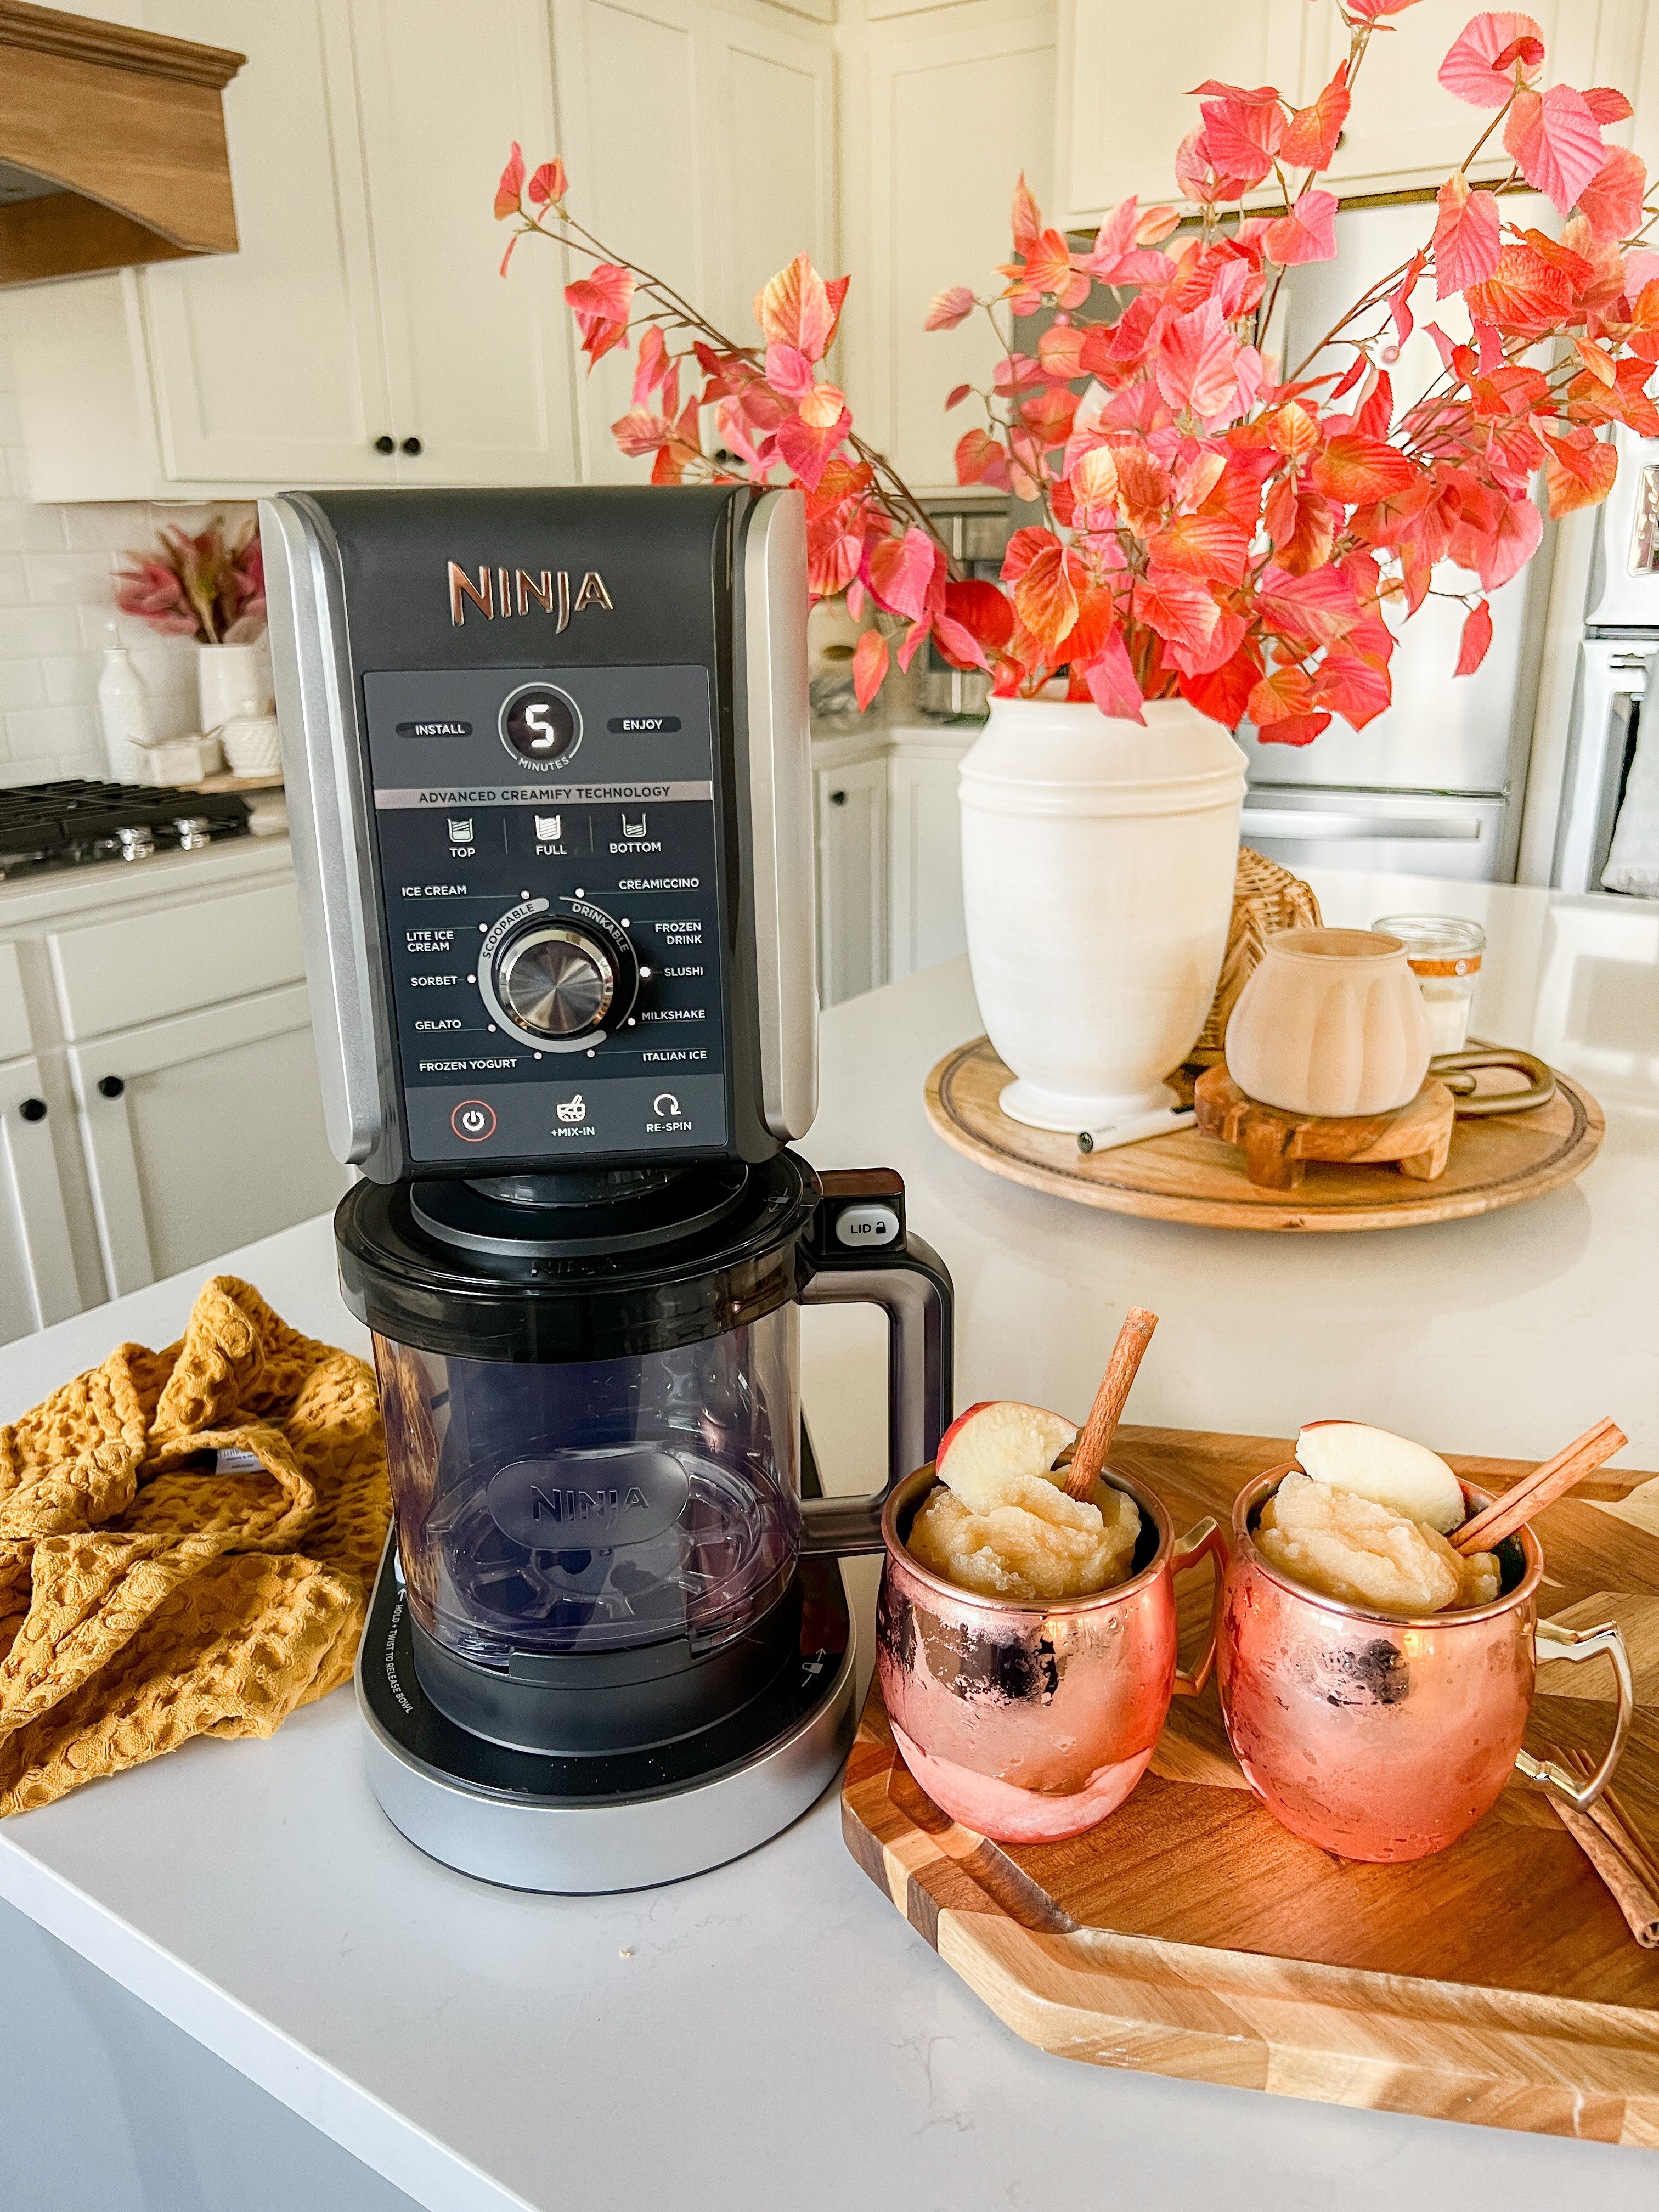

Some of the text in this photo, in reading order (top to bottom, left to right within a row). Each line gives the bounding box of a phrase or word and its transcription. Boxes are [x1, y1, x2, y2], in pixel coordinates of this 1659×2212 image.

[448, 561, 613, 634] NINJA
[415, 724, 466, 735] INSTALL
[526, 704, 554, 747] 5
[623, 720, 663, 731] ENJOY
[518, 755, 569, 772] MINUTES
[419, 786, 670, 803] ADVANCED CREAMIFY TECHNOLOGY
[449, 848, 476, 858] TOP
[535, 845, 567, 856] FULL
[610, 842, 661, 854] BOTTOM
[618, 878, 699, 890] CREAMICCINO
[402, 885, 467, 896] ICE CREAM
[483, 903, 534, 959] SCOOPABLE
[571, 903, 629, 952] DRINKABLE
[655, 922, 701, 933] FROZEN
[406, 931, 454, 942] LITE ICE
[666, 934, 702, 945] DRINK
[407, 942, 449, 952] CREAM
[664, 967, 703, 977] SLUSHI
[410, 976, 458, 986] SORBET
[642, 1009, 705, 1020] MILKSHAKE
[415, 1019, 462, 1030] GELATO
[642, 1050, 707, 1062] ITALIAN ICE
[419, 1059, 517, 1072] FROZEN YOGURT
[550, 1126, 595, 1137] +MIX-IN
[646, 1121, 692, 1133] RE-SPIN
[850, 1224, 871, 1234] LID
[531, 1485, 650, 1530] NINJA
[392, 1604, 403, 1623] HOLD
[386, 1629, 397, 1651] TWIST
[386, 1652, 393, 1662] TO
[386, 1663, 401, 1694] RELEASE
[396, 1692, 413, 1713] BOWL
